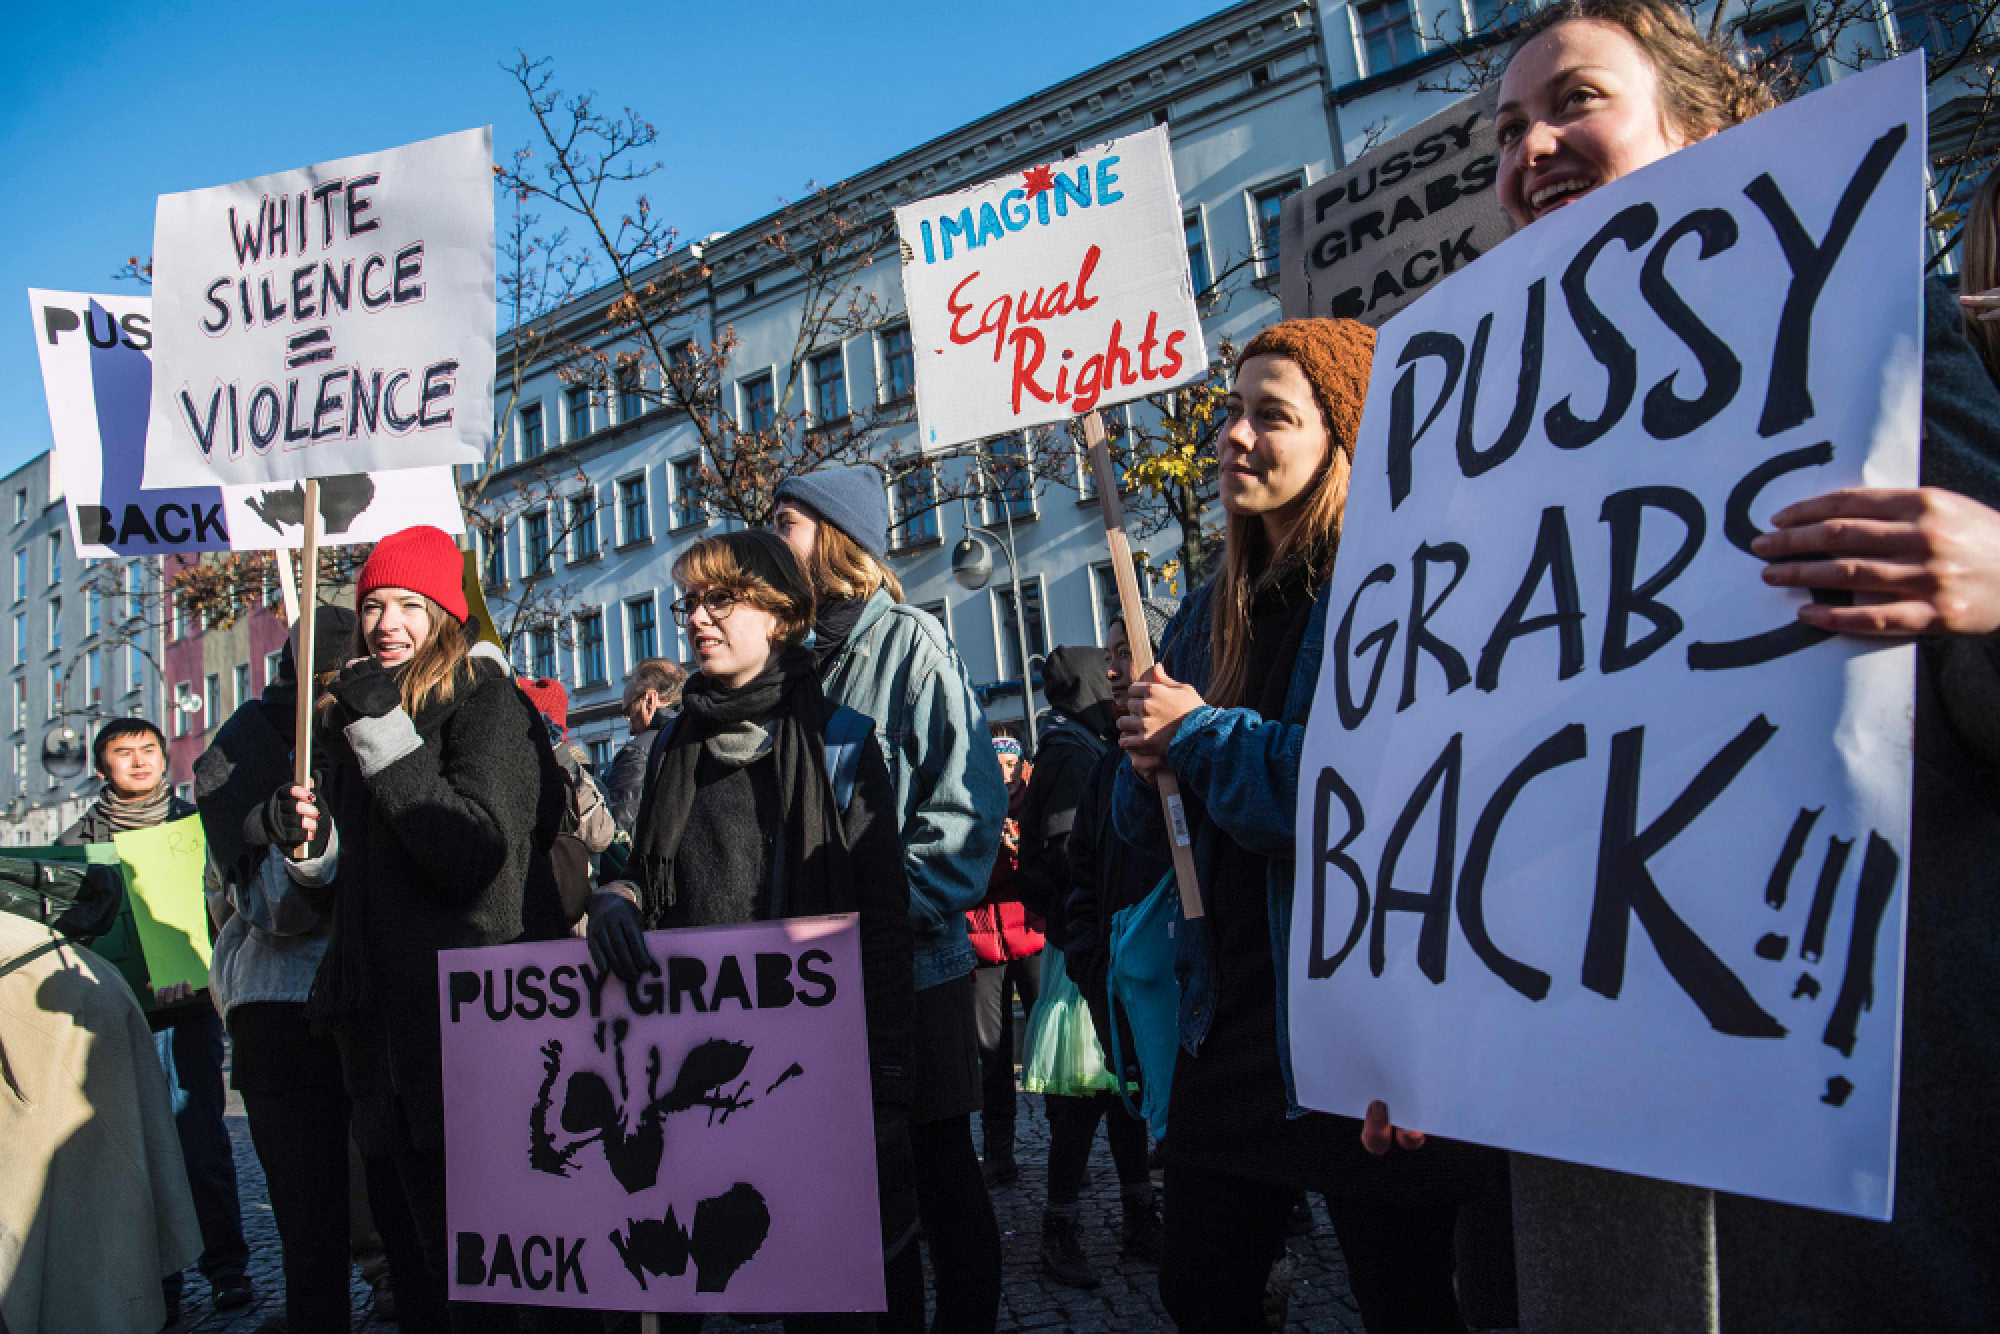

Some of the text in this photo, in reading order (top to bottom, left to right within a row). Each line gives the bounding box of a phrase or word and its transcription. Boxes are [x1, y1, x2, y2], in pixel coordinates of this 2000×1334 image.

[920, 155, 1124, 264] IMAGINE
[1311, 154, 1498, 268] GRABS
[1315, 111, 1482, 223] PUSSY
[229, 171, 382, 270] WHITE
[1331, 226, 1482, 318] BACK
[43, 305, 152, 351] PUS
[200, 241, 426, 337] SILENCE
[948, 244, 1101, 362] Equal
[1387, 122, 1908, 512] PUSSY
[176, 358, 459, 462] VIOLENCE
[1008, 310, 1187, 416] Rights
[76, 502, 230, 546] BACK
[1333, 441, 1854, 731] GRABS
[449, 949, 838, 1023] PUSSY GRABS
[455, 1231, 588, 1294] BACK
